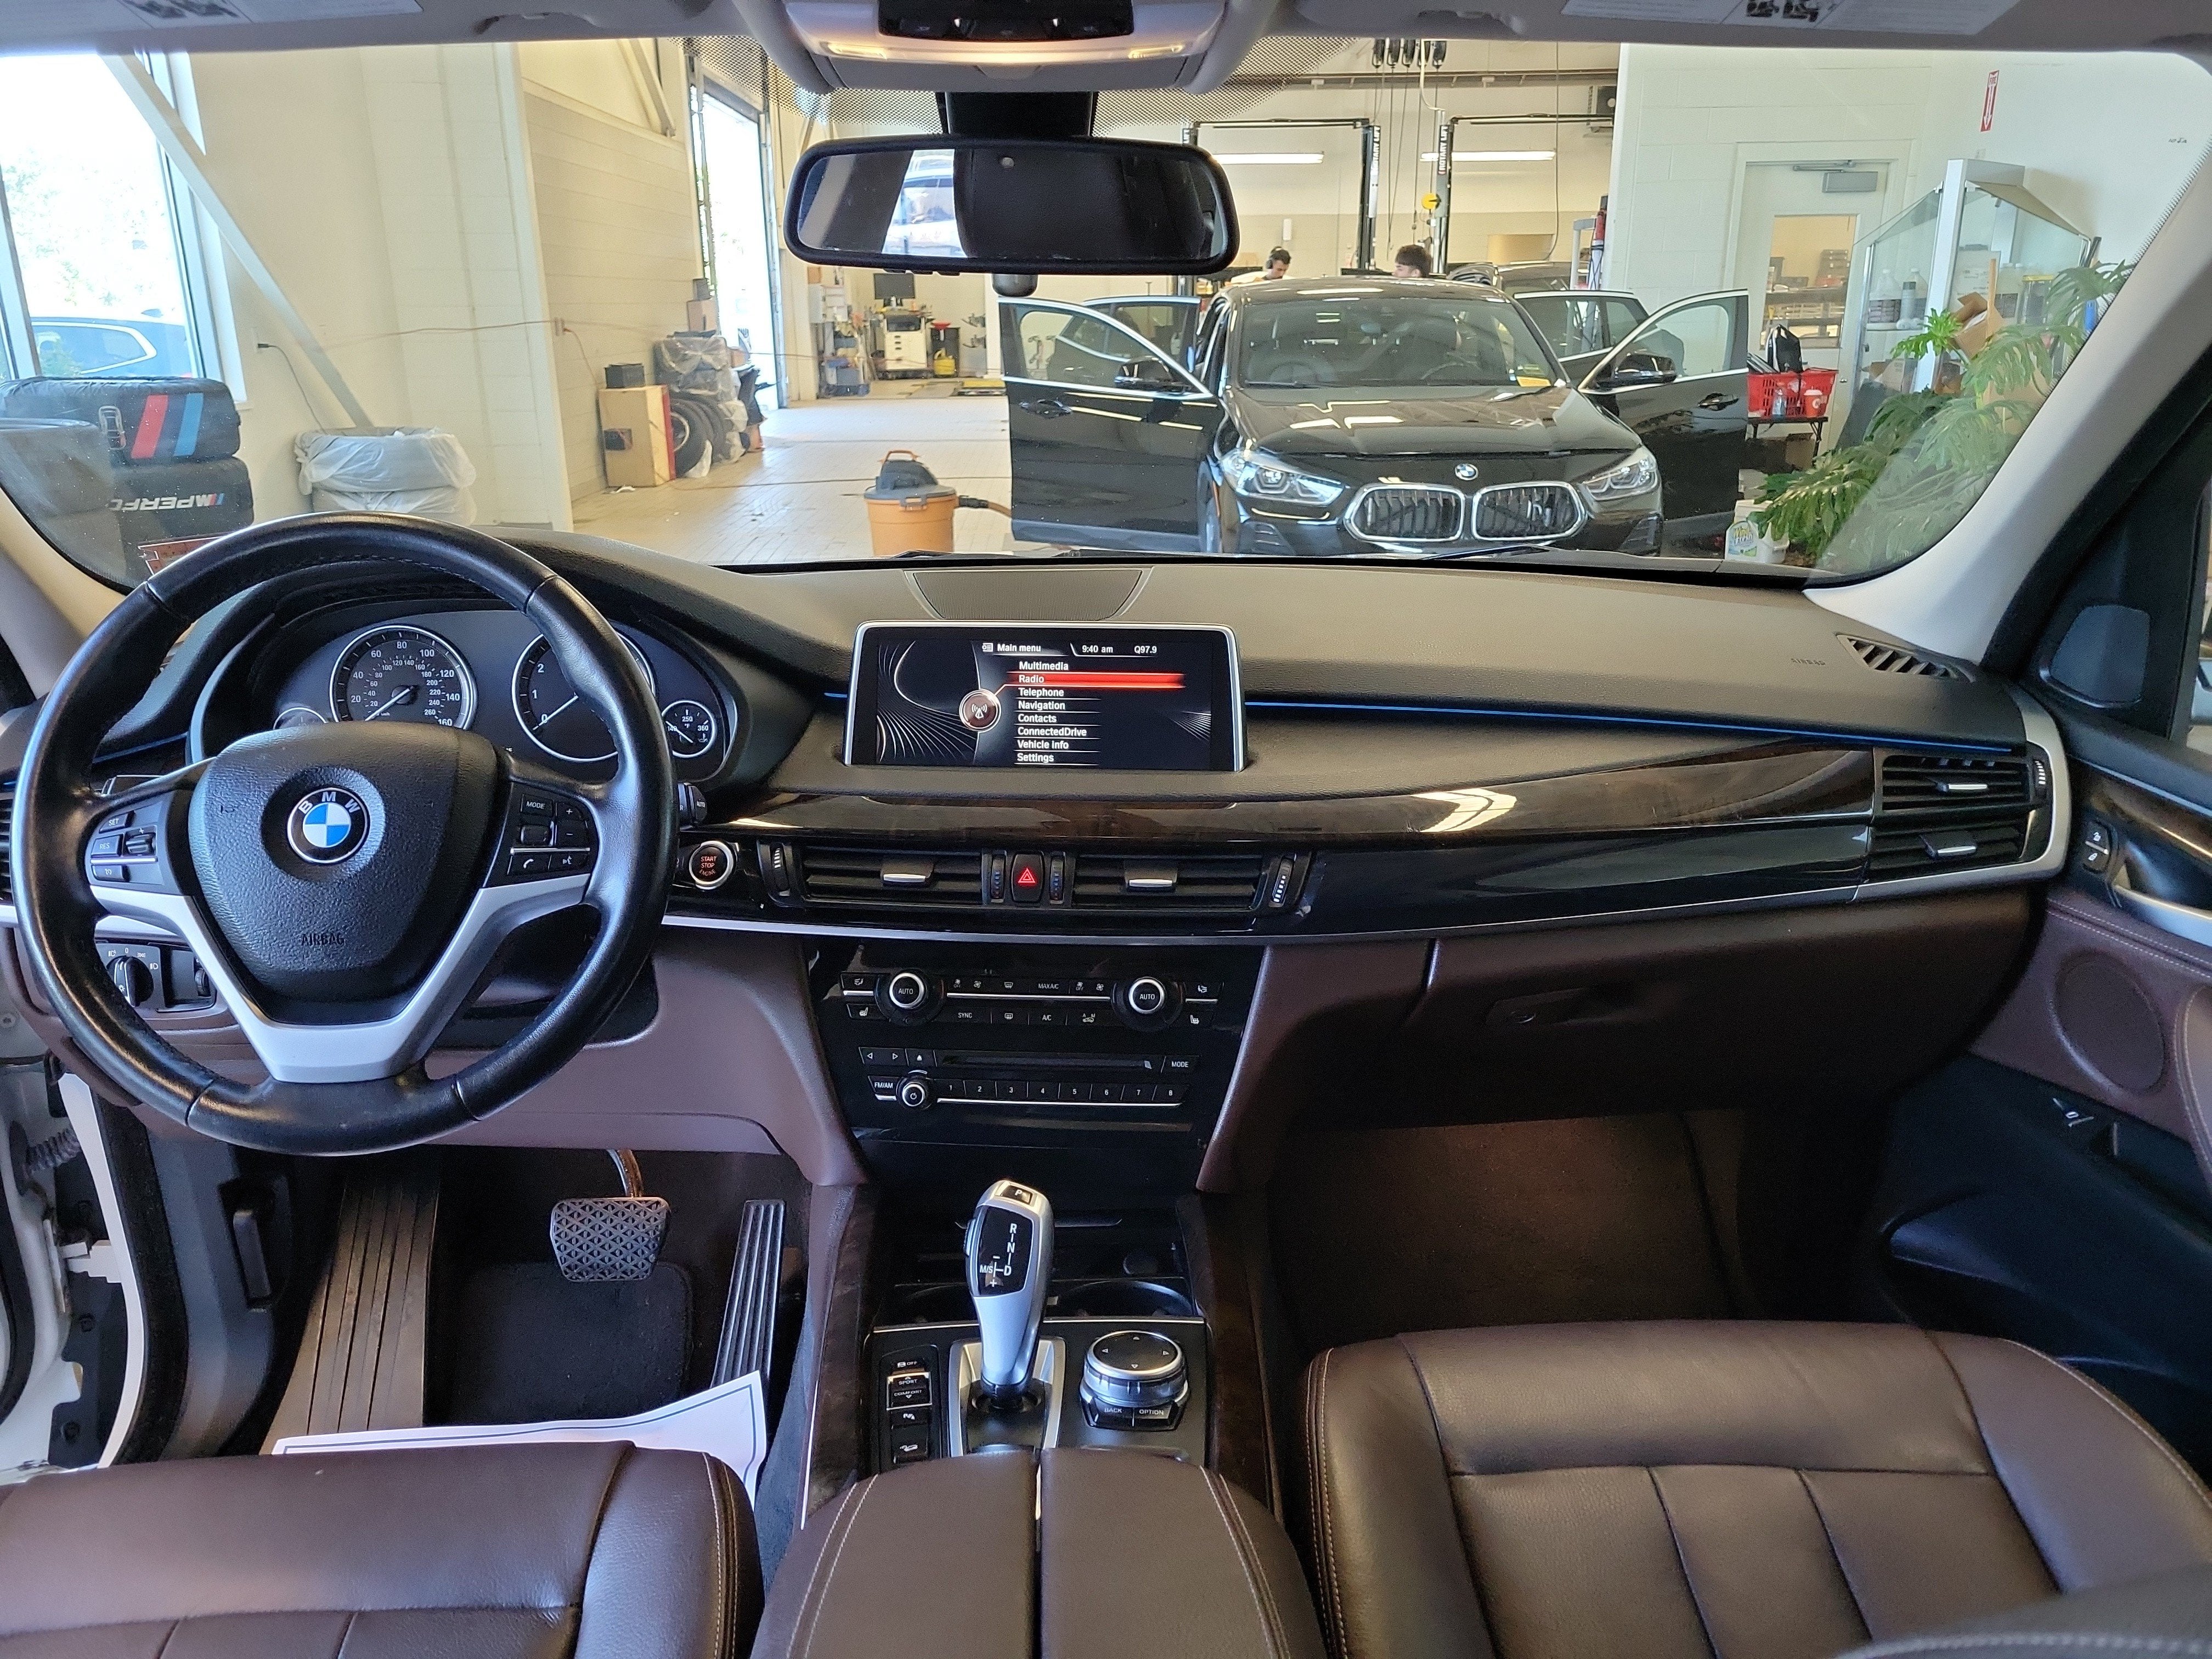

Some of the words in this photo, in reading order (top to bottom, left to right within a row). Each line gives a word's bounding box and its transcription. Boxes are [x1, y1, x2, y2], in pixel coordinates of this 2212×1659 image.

[396, 641, 407, 649] 80
[997, 643, 1017, 652] Main
[1082, 645, 1098, 653] 9:40
[1133, 645, 1158, 654] Q97.9
[371, 650, 381, 658] 60
[537, 664, 545, 673] 2
[1019, 662, 1069, 670] Multimedia
[353, 671, 363, 679] 40
[439, 669, 454, 678] 120
[1018, 675, 1045, 684] Radio
[445, 693, 460, 701] 140
[532, 690, 537, 698] 1
[1018, 688, 1064, 698] Telephone
[1018, 701, 1066, 710] Navigation
[1017, 714, 1057, 723] Contacts
[1017, 727, 1087, 736] ConnectedDrive
[1017, 740, 1049, 749] Vehicle
[1052, 740, 1069, 749] Info
[1017, 753, 1054, 763] Settings
[298, 792, 360, 814] BMW
[526, 802, 545, 810] MODE
[302, 933, 346, 945] AIRBAG
[1009, 1223, 1017, 1233] R
[1007, 1242, 1015, 1253] N
[1004, 1265, 1012, 1276] D
